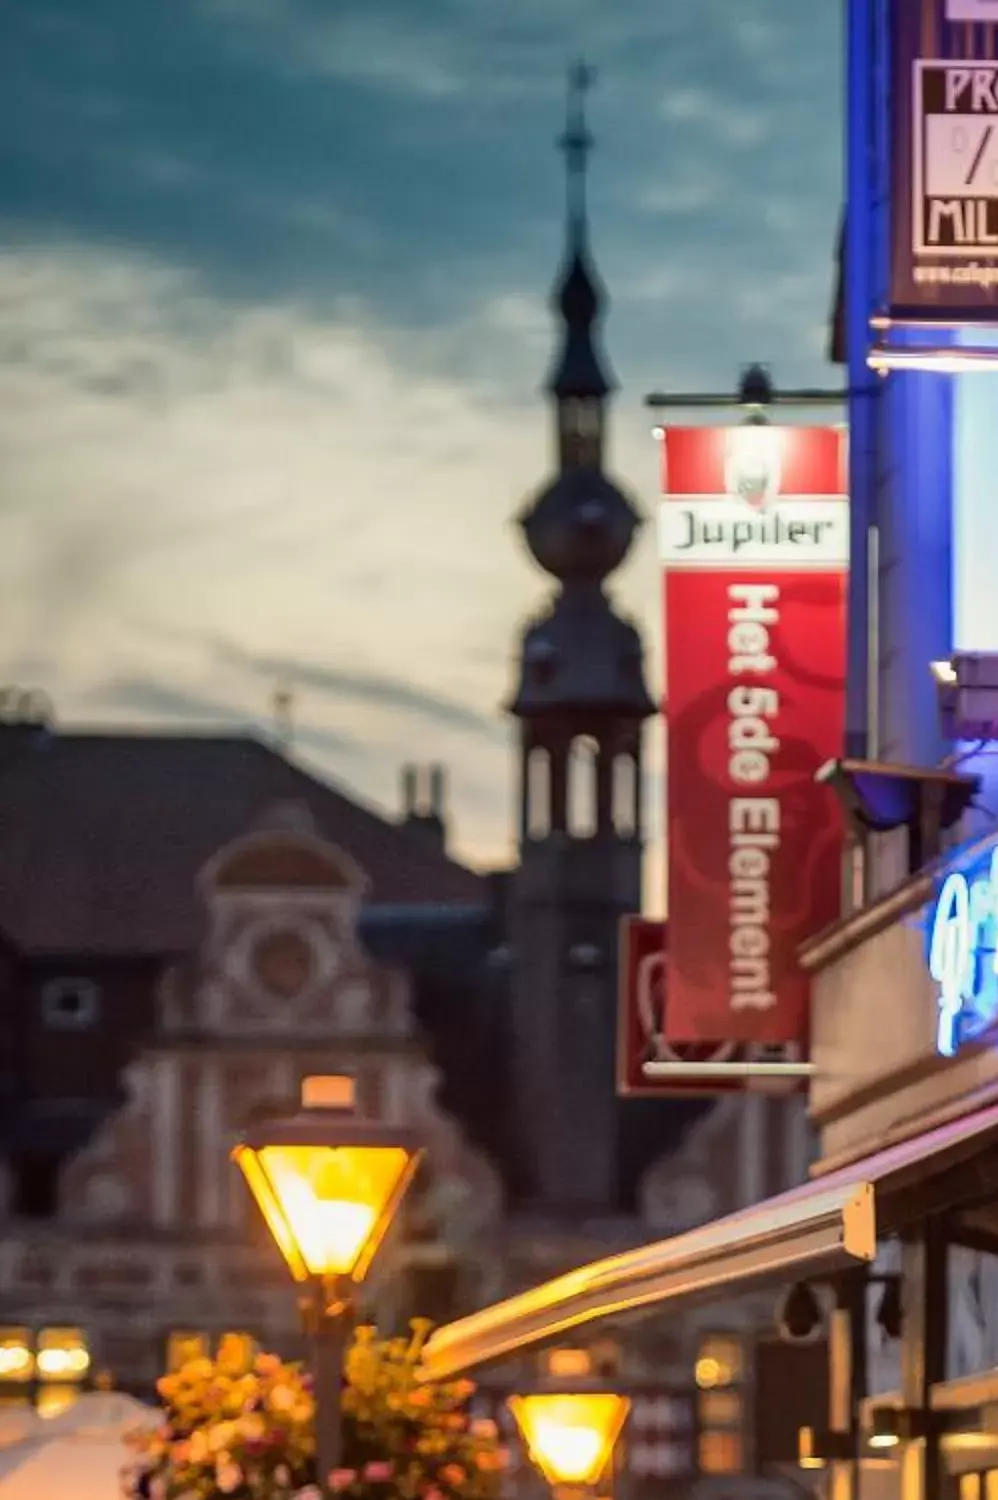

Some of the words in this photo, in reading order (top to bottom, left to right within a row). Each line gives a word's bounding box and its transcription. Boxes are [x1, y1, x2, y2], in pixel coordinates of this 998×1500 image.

[673, 511, 834, 553] Jupiler
[726, 583, 780, 675] Het
[726, 684, 781, 785] 5de
[727, 796, 782, 1011] Element
